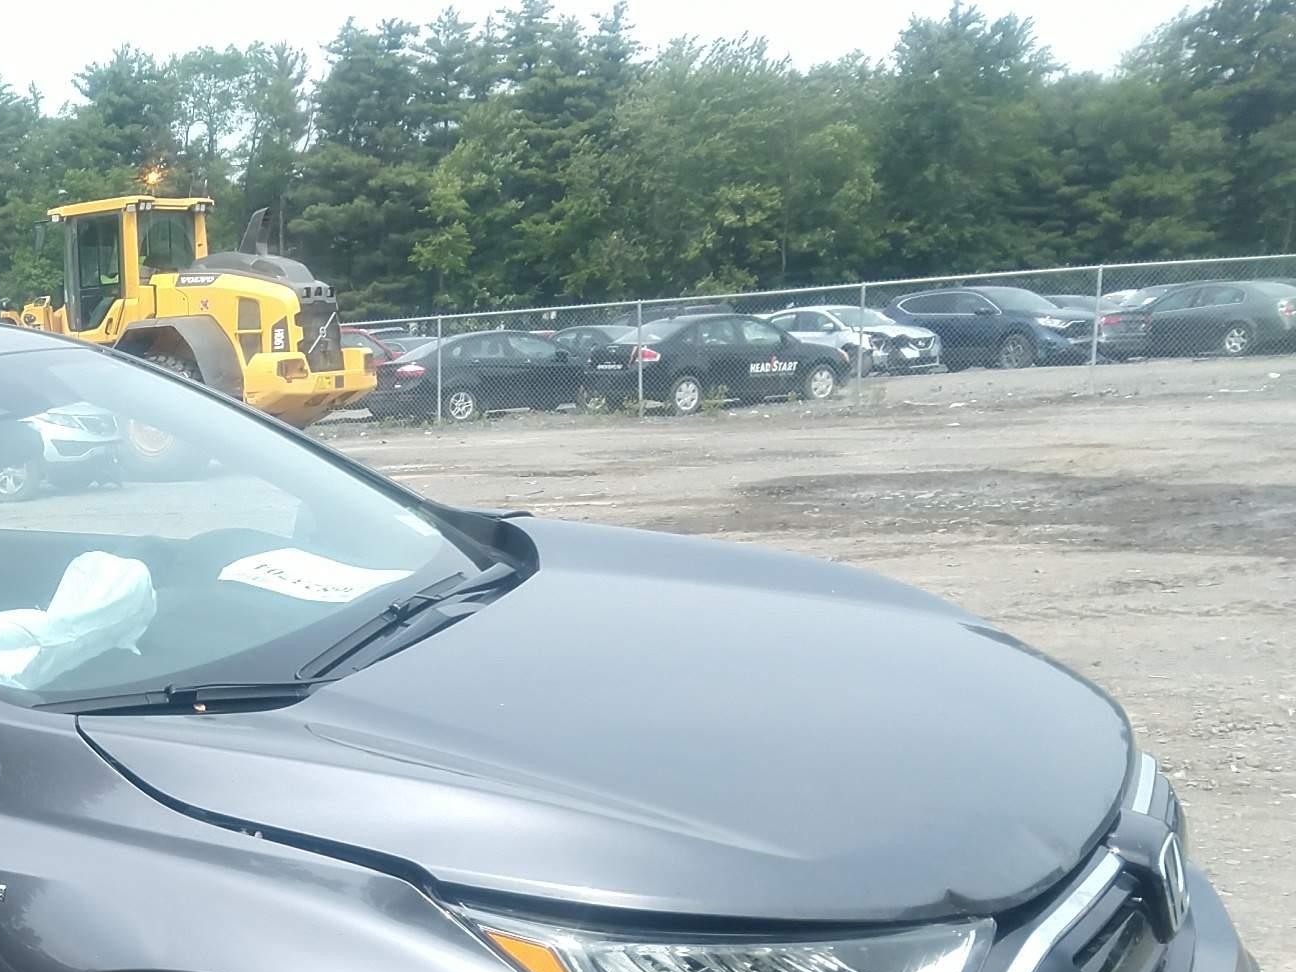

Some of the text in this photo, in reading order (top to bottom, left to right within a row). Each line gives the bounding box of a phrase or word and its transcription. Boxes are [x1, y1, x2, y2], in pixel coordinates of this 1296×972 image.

[180, 275, 215, 284] VOLVO
[750, 360, 798, 373] HEAD START
